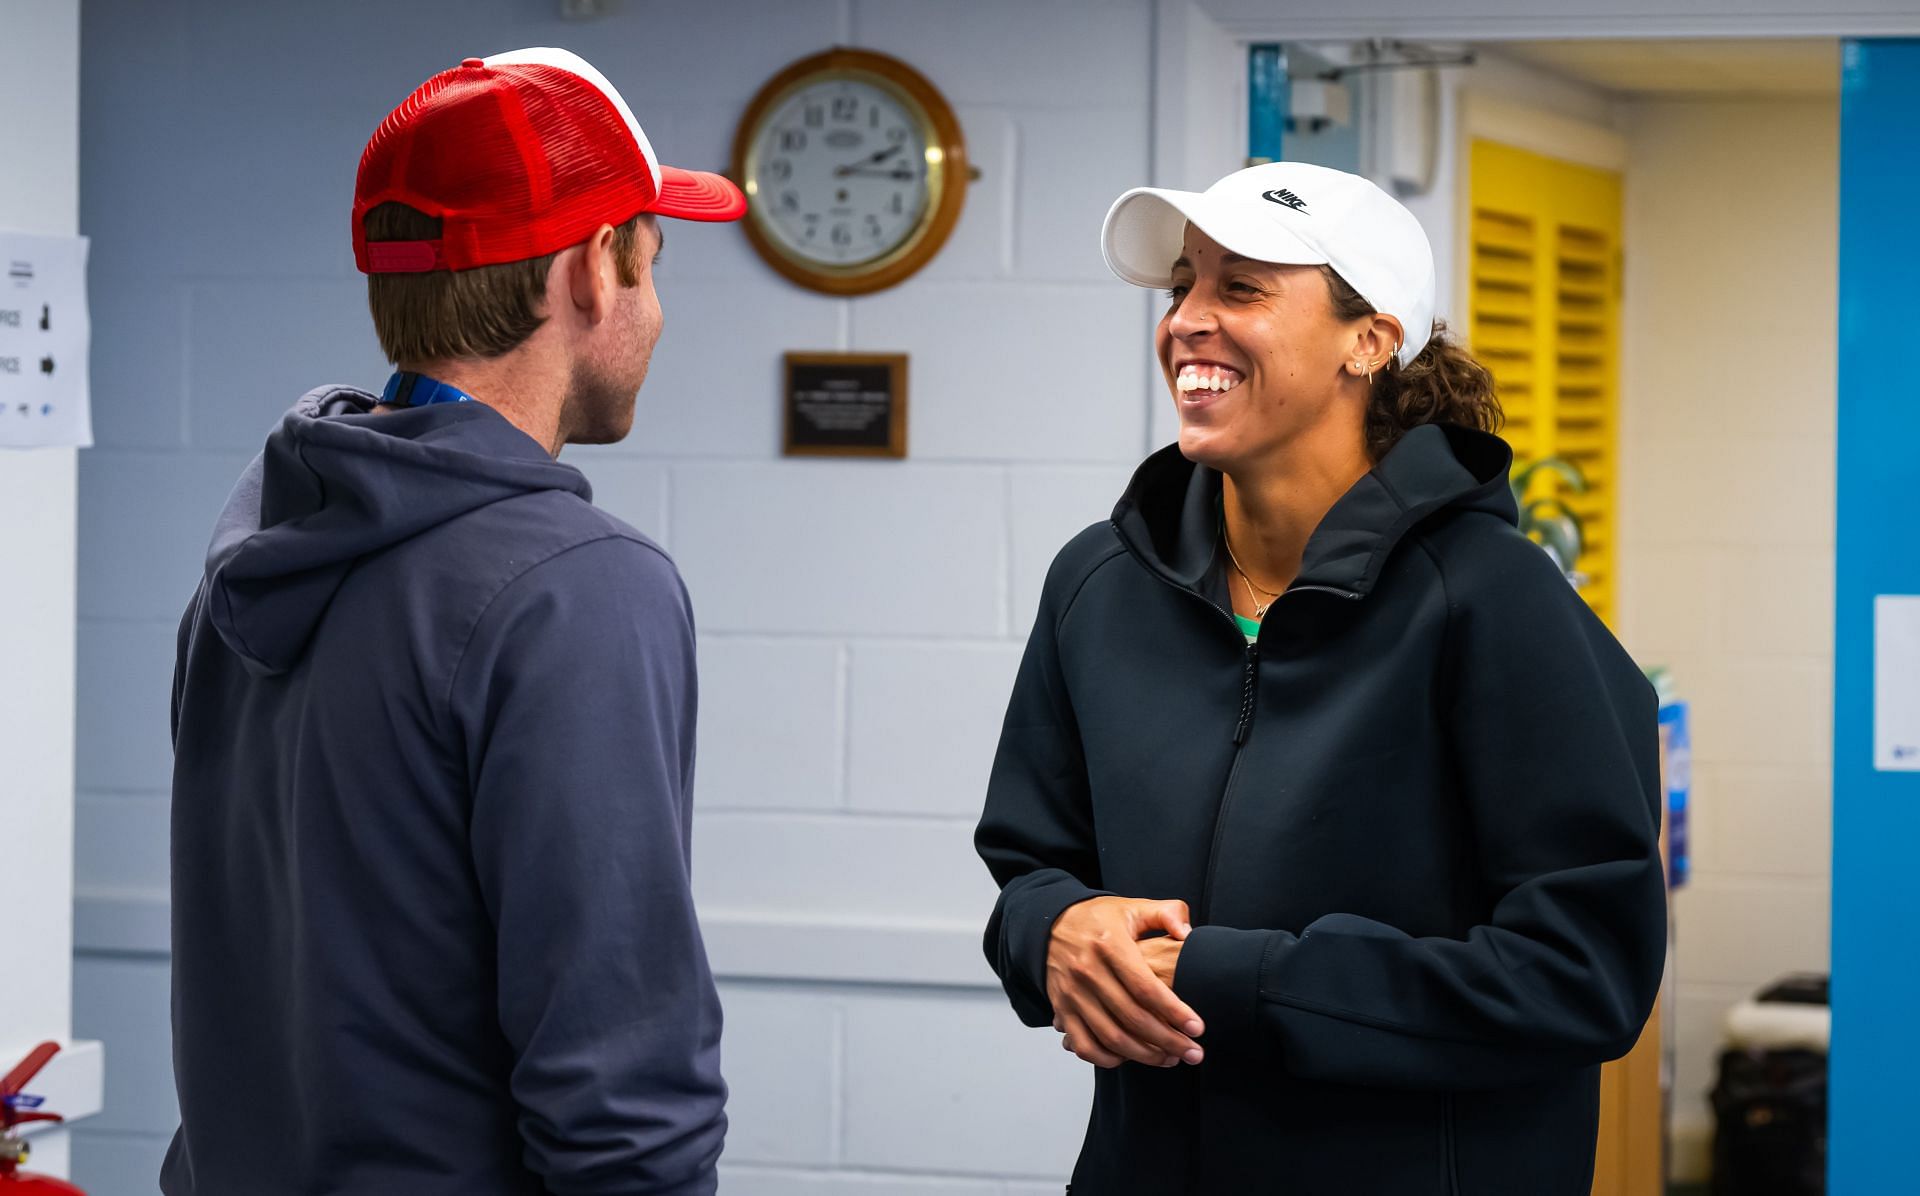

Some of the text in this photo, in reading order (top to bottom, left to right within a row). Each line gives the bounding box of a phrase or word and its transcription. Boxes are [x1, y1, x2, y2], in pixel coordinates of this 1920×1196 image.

[832, 97, 859, 121] 12
[780, 129, 808, 152] 10
[1273, 188, 1307, 210] NIKE
